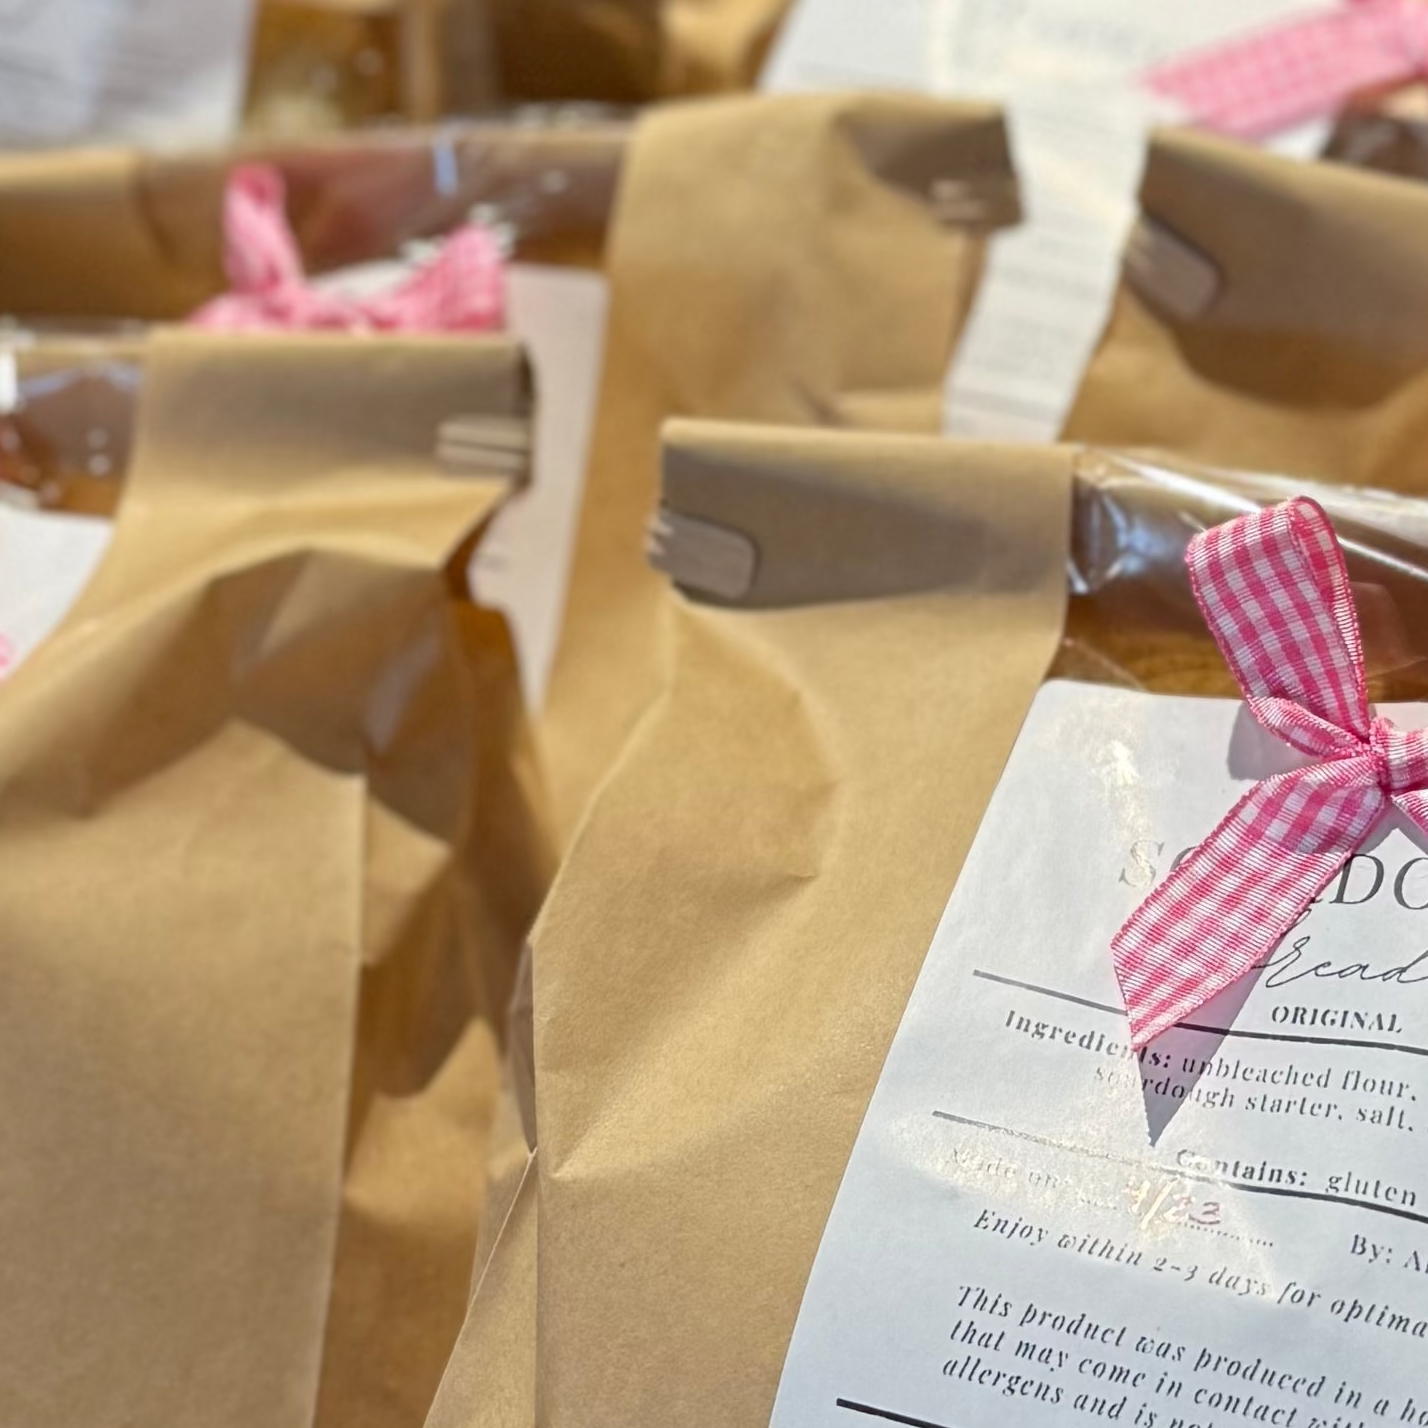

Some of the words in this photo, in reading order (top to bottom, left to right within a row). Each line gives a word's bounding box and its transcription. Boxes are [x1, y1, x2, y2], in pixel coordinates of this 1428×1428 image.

[1271, 1005, 1404, 1035] ORIGINAL
[1182, 1056, 1331, 1090] unbleached
[1341, 1070, 1417, 1102] flour,
[1245, 1092, 1344, 1121] starter,
[1356, 1104, 1414, 1133] salt,
[1175, 1147, 1309, 1187] Contains:
[1327, 1171, 1418, 1207] gluten
[974, 1208, 1048, 1247] Enjoy
[1057, 1230, 1143, 1267] within
[1153, 1256, 1199, 1283] 2-3
[1209, 1266, 1272, 1297] days
[1277, 1280, 1322, 1309] for
[1351, 1234, 1393, 1264] By:
[950, 1319, 1006, 1352] that
[1014, 1339, 1069, 1373] may
[1078, 1356, 1147, 1389] come
[1155, 1371, 1184, 1398] in
[1193, 1385, 1299, 1428] contact
[958, 1285, 1013, 1319] This
[1019, 1303, 1127, 1348] product
[1134, 1335, 1187, 1362] was
[1193, 1347, 1327, 1398] produced
[1333, 1381, 1363, 1409] in
[1373, 1398, 1390, 1416] a
[942, 1355, 1065, 1405] allergens
[1072, 1392, 1128, 1421] and
